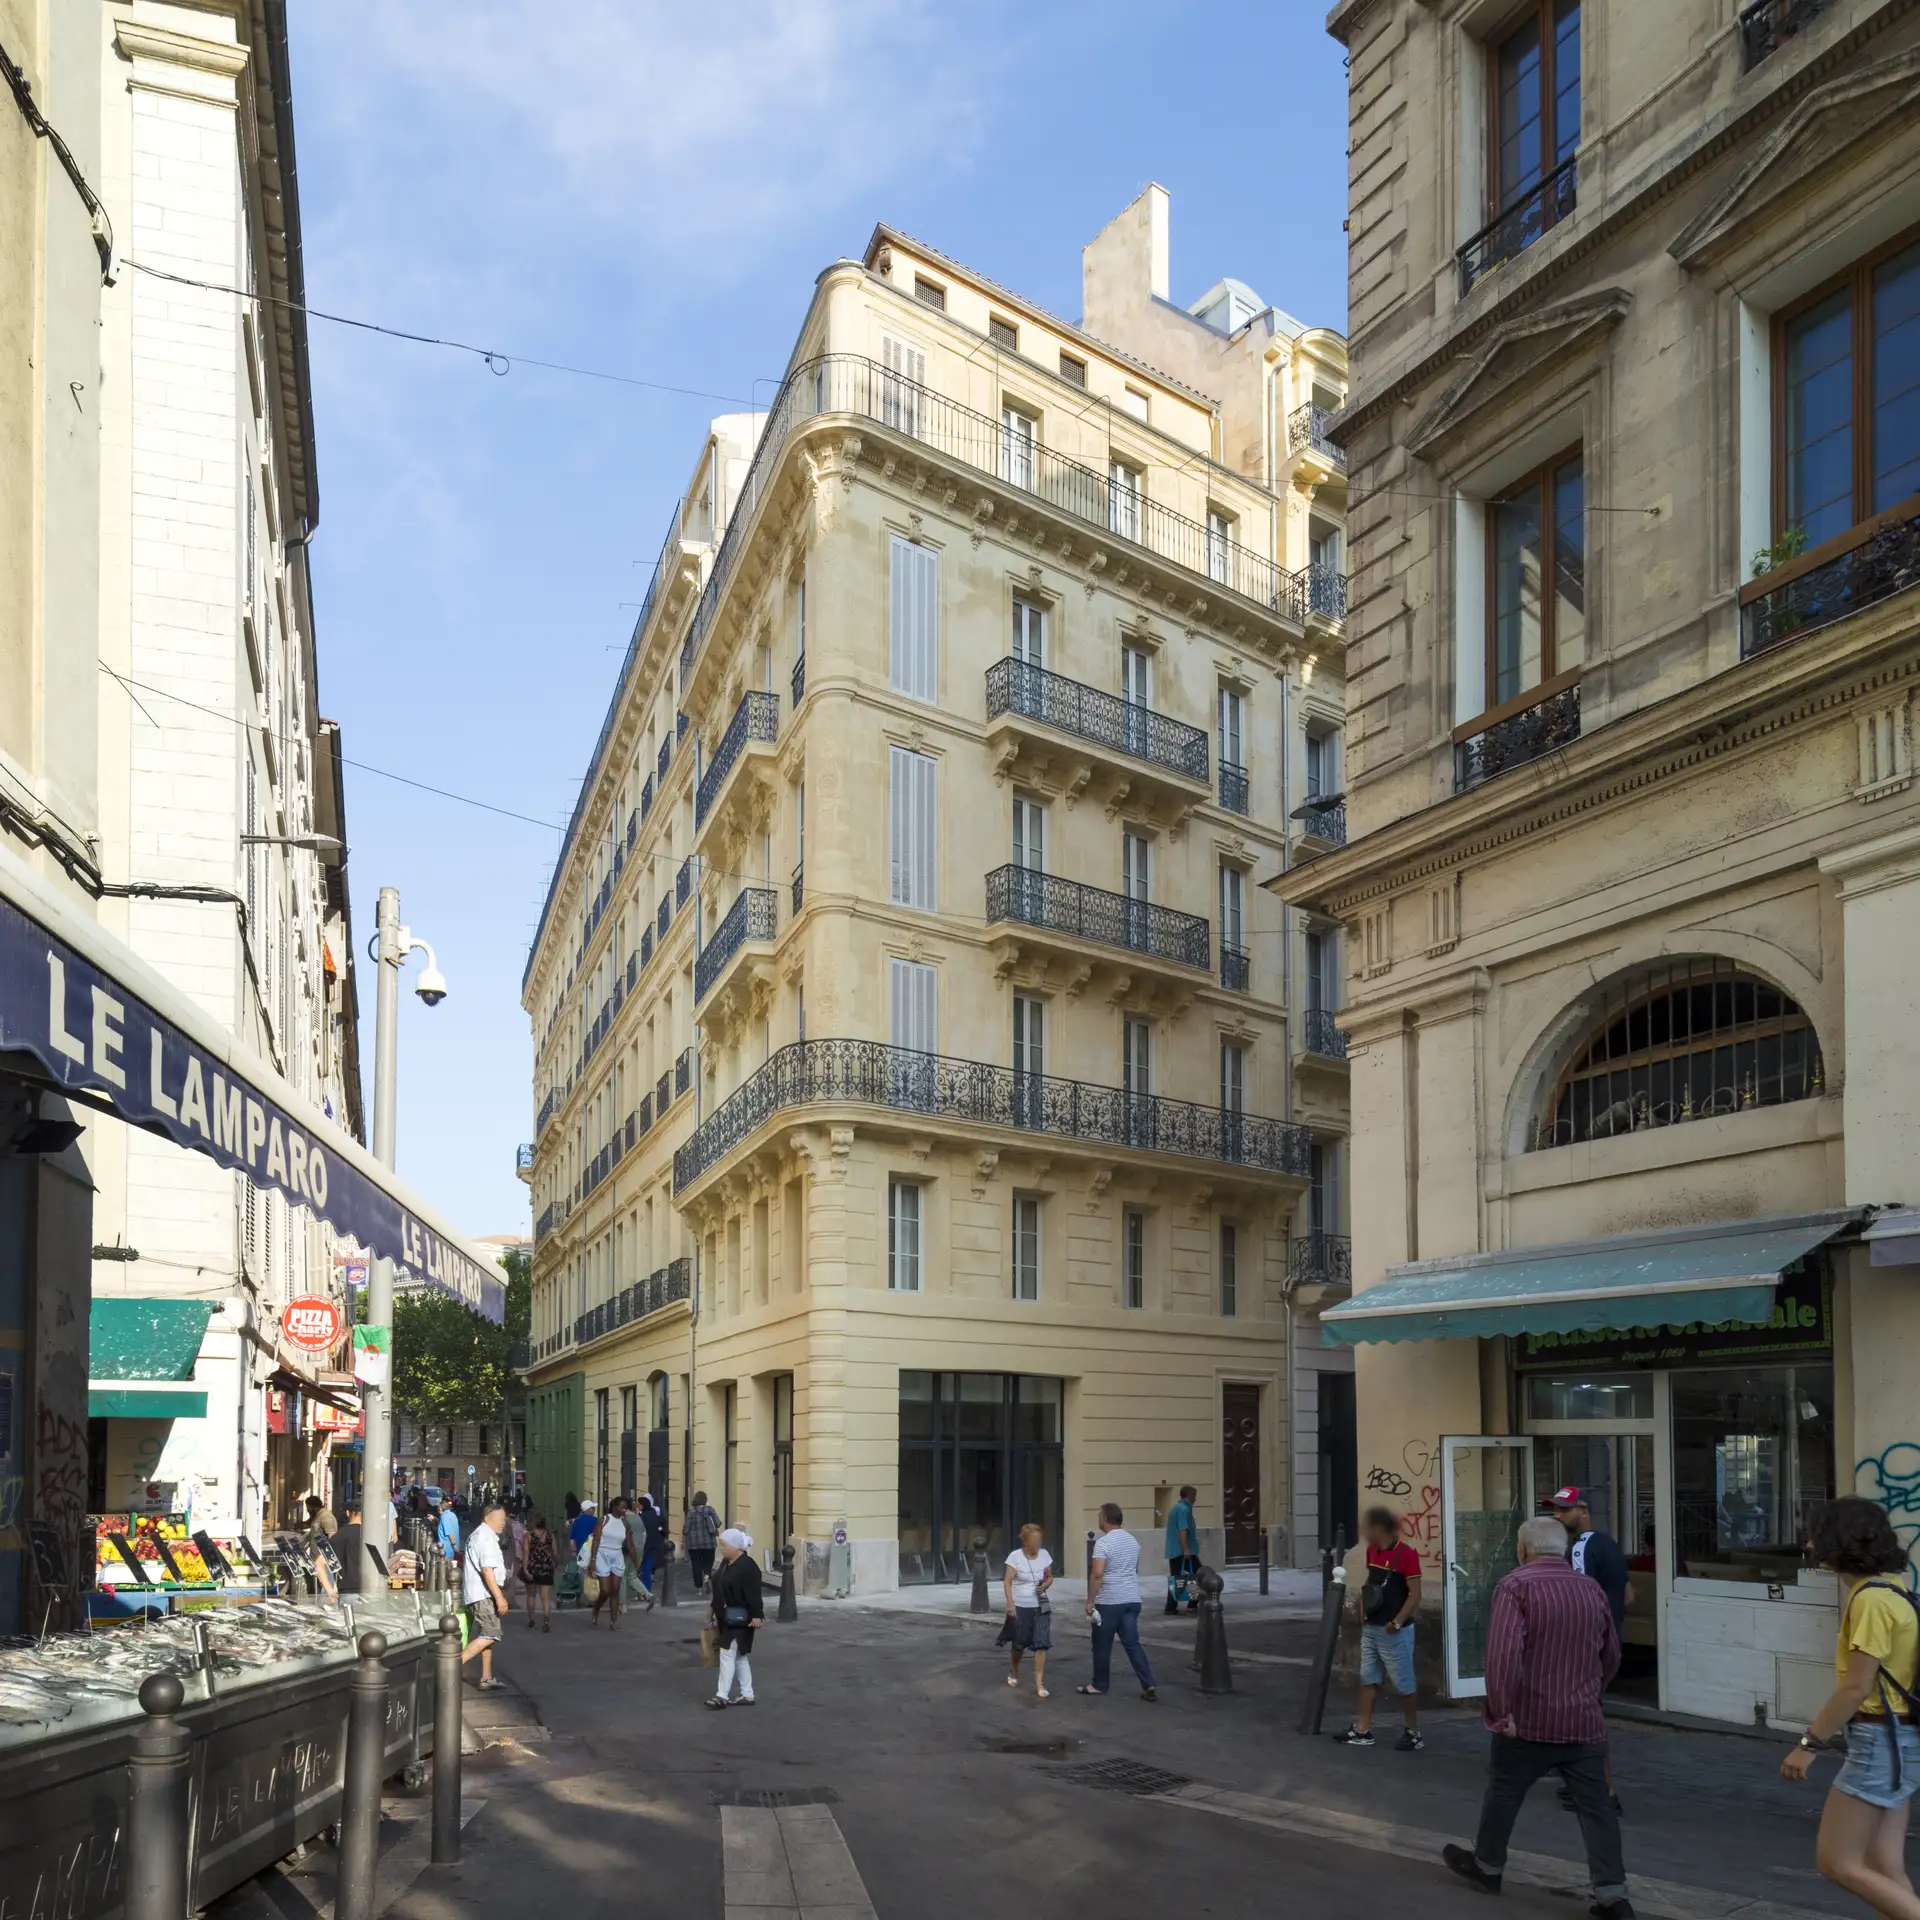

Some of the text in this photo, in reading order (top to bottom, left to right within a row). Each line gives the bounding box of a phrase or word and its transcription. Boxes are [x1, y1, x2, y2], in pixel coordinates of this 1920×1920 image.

[50, 953, 328, 1208] LE LAMPARO
[402, 1212, 482, 1305] LE LAMPARO
[288, 1322, 335, 1336] Charly
[290, 1308, 333, 1326] PIZZA
[1667, 1296, 1817, 1336] orenale
